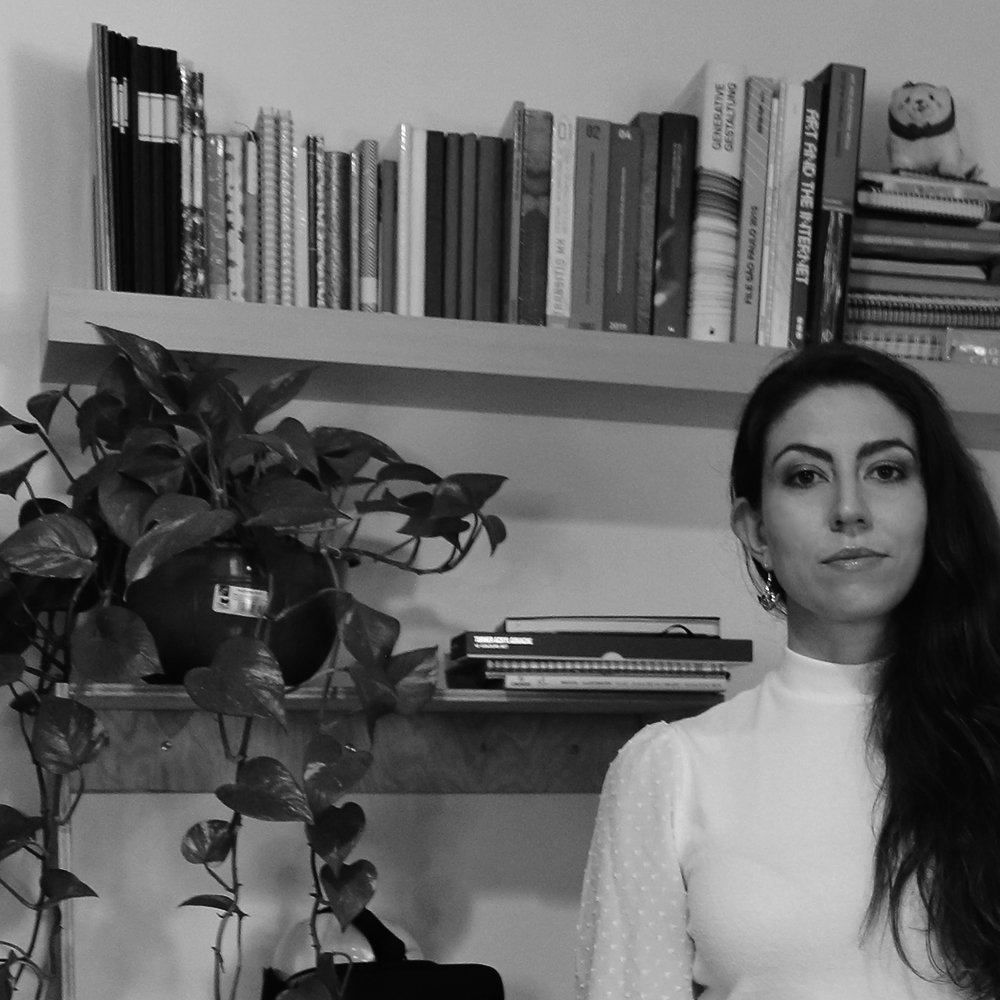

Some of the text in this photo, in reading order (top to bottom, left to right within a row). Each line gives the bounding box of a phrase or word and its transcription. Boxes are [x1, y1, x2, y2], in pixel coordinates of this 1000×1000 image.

[585, 124, 601, 140] 02
[711, 83, 725, 150] GENERATIVE
[723, 82, 737, 152] GESTALTUNG
[795, 108, 820, 285] ART AND THE INTERNET
